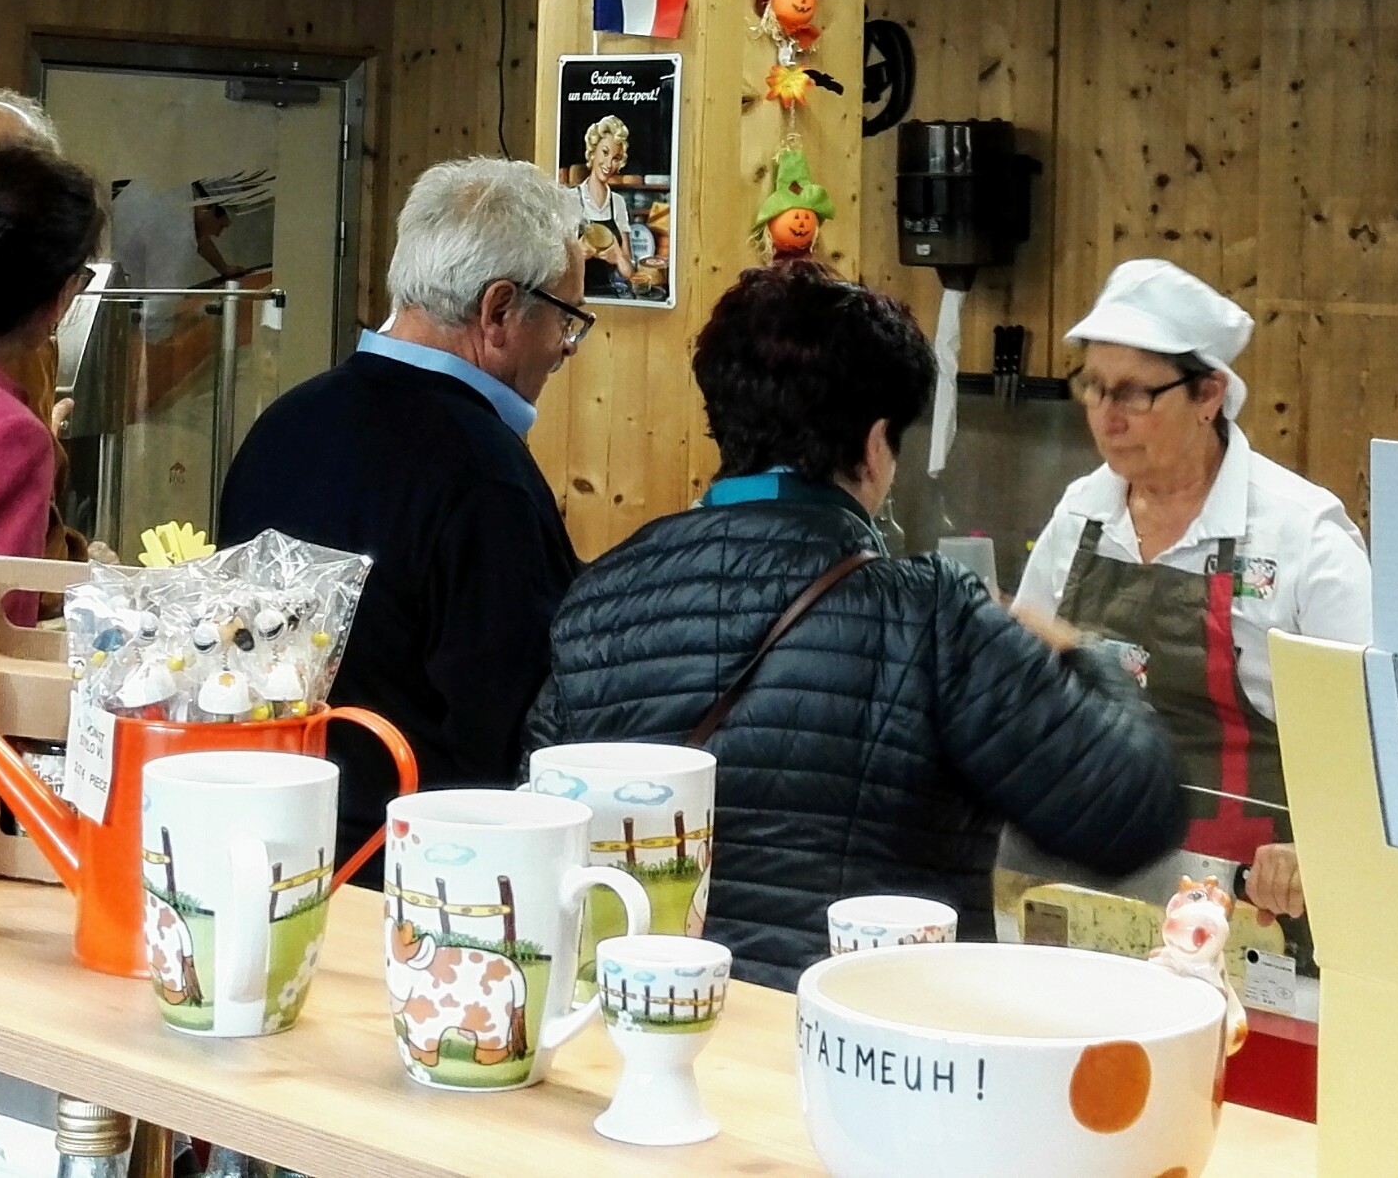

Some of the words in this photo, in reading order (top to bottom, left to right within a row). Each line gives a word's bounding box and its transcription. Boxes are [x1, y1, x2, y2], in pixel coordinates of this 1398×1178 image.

[568, 92, 581, 101] un
[582, 88, 611, 101] métier
[612, 86, 660, 105] d'expert!
